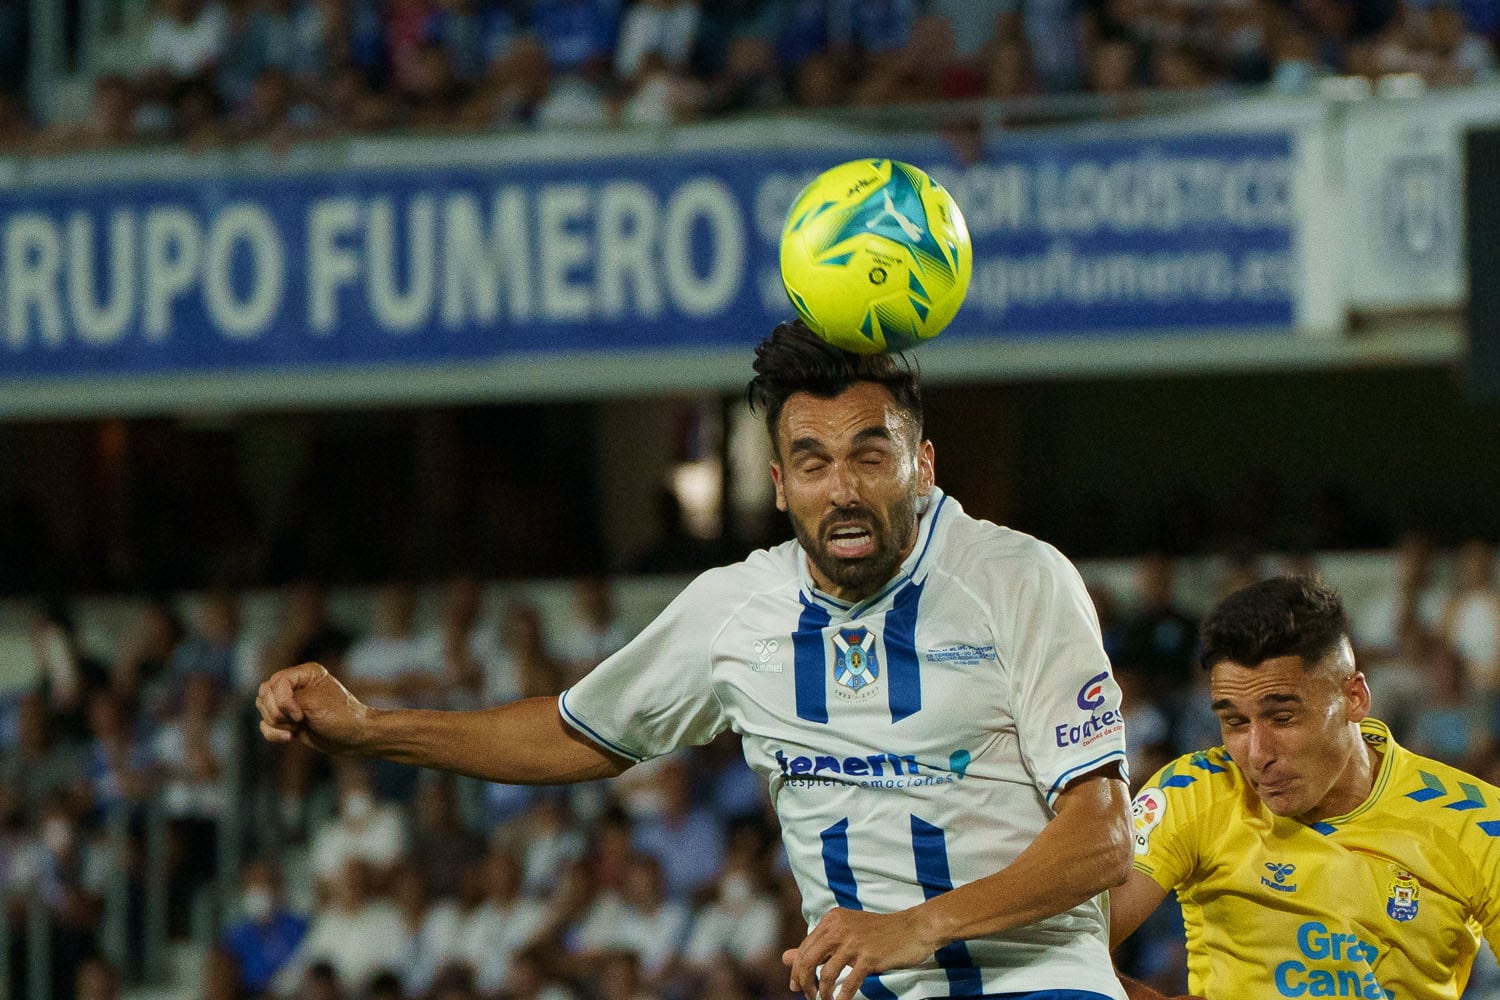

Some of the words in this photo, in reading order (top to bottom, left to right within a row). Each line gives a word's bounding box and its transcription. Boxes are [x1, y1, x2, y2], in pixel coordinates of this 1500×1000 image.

[305, 174, 747, 338] FUMERO
[861, 774, 954, 790] emociones
[1260, 875, 1298, 893] hummel
